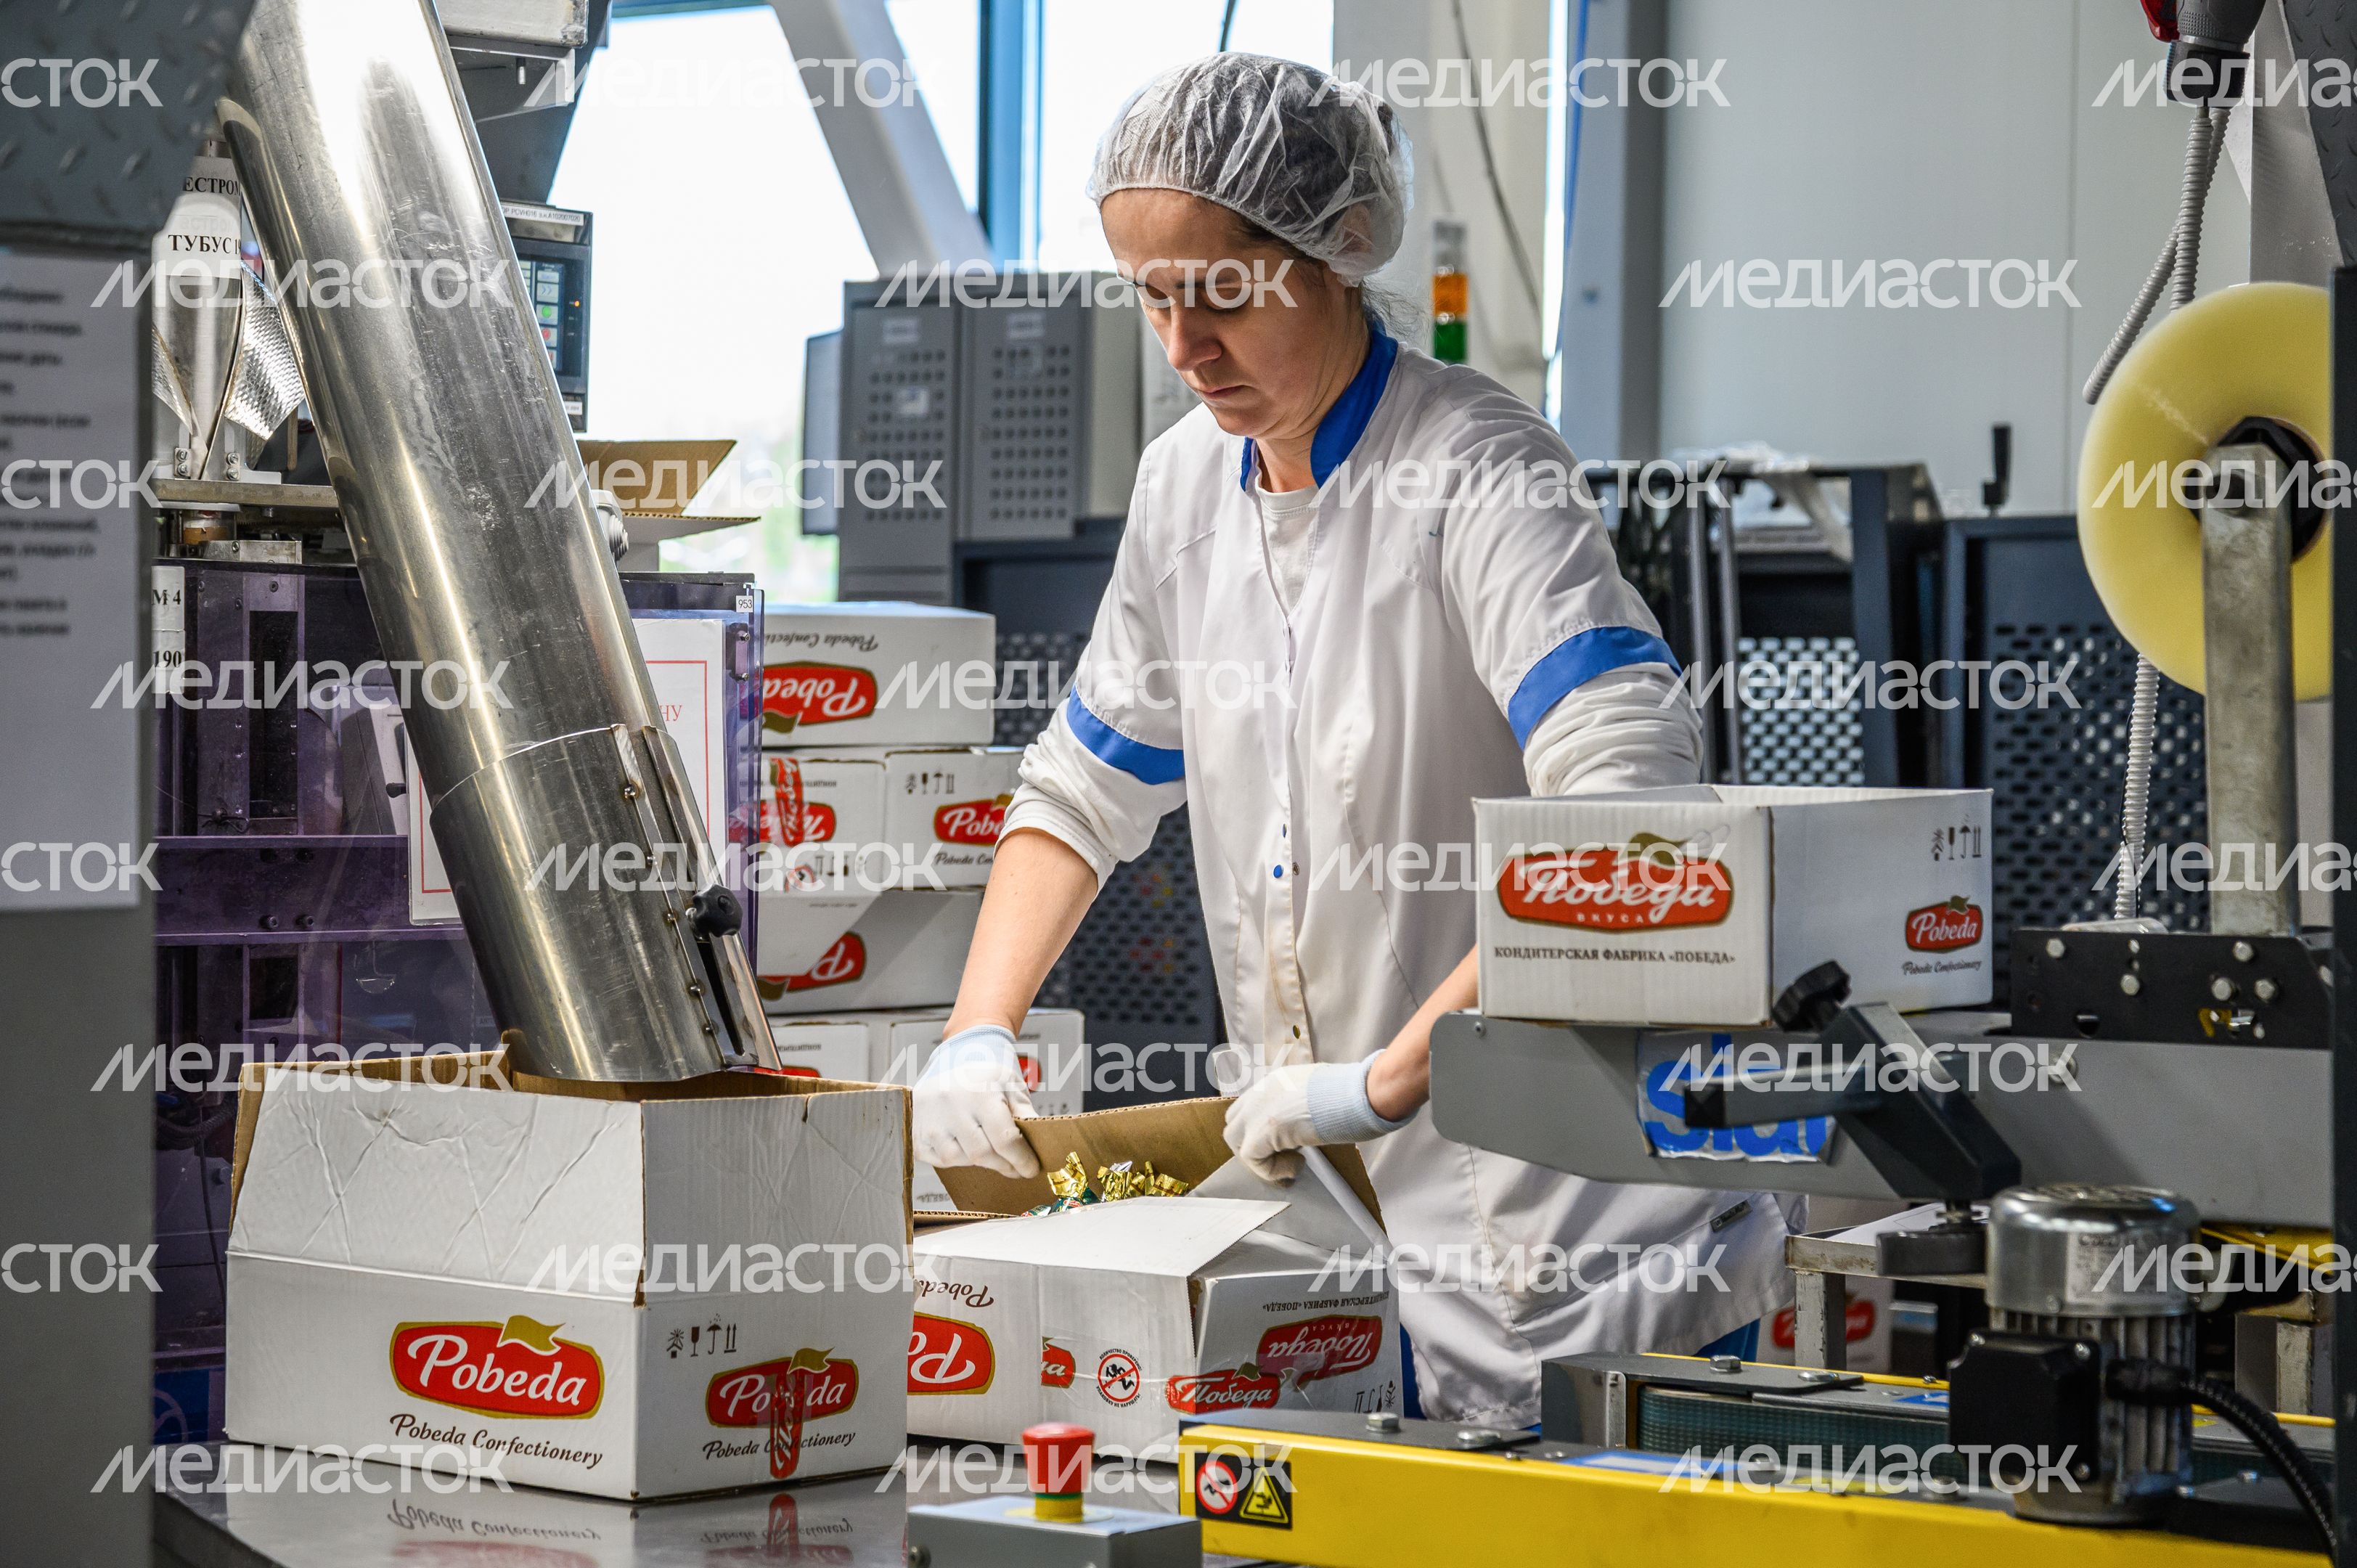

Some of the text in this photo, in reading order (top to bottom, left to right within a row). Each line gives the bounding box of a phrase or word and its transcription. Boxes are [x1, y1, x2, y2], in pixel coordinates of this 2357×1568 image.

[168, 234, 232, 254] ТУБУС
[173, 589, 181, 605] 4
[738, 599, 753, 609] 953
[153, 650, 182, 669] 190
[1911, 912, 1978, 944] Pobeda
[1494, 947, 1598, 961] КОНДИТЕРСКАЯ
[1602, 948, 1666, 963] ФАБРИКА
[1304, 1298, 1341, 1309] ФАБРИКА
[407, 1334, 587, 1406] Pobeda
[720, 1374, 846, 1418] Poda
[1175, 1376, 1273, 1408] Победа
[389, 1413, 602, 1470] Pobeda Confectionery
[703, 1440, 761, 1460] Pobeda
